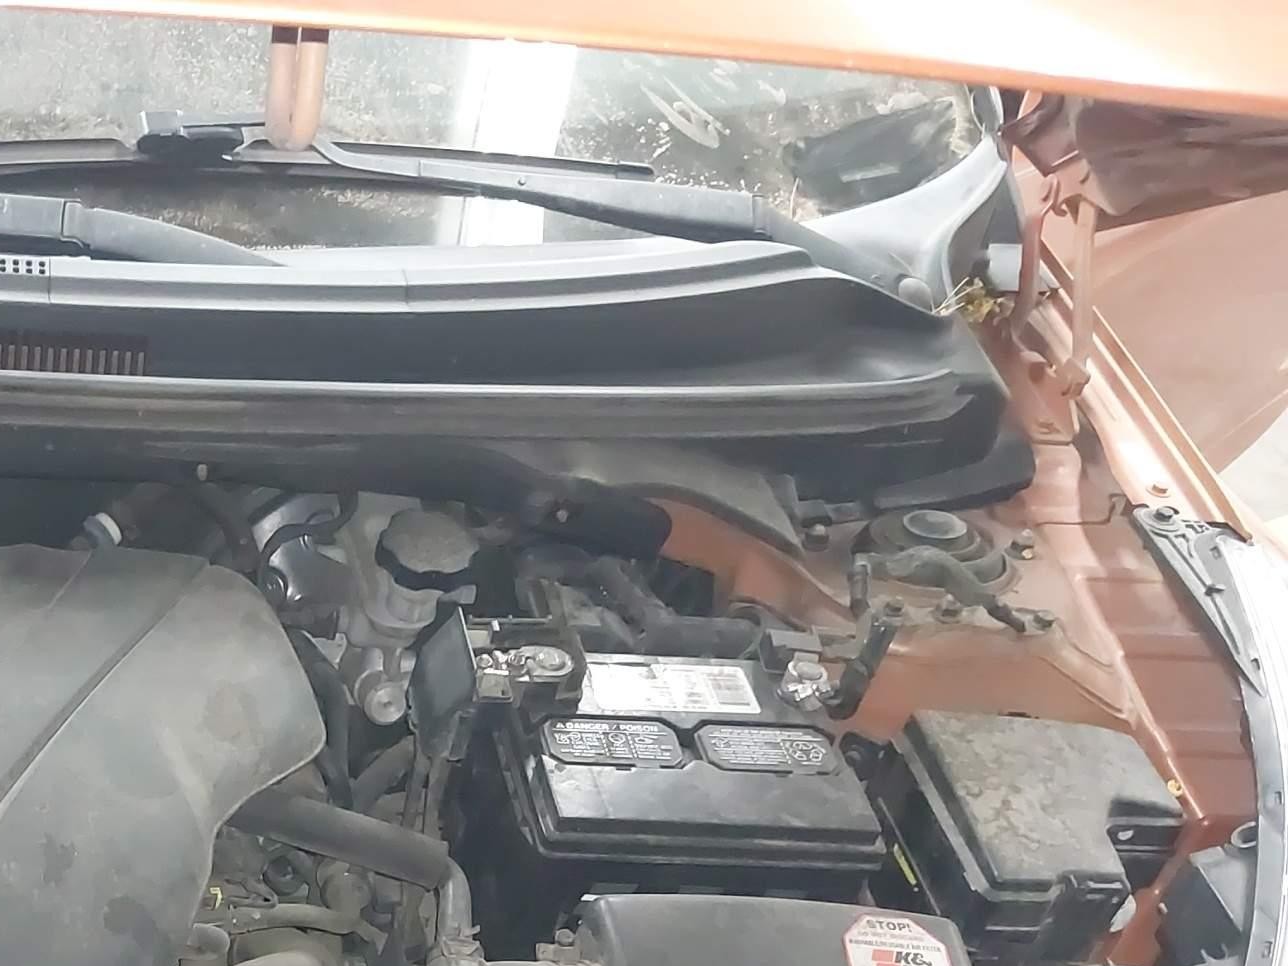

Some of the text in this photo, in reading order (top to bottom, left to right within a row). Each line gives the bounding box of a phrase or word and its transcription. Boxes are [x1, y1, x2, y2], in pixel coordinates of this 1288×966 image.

[565, 722, 610, 731] DANGER
[619, 723, 659, 732] POISON
[866, 919, 913, 933] STOP!
